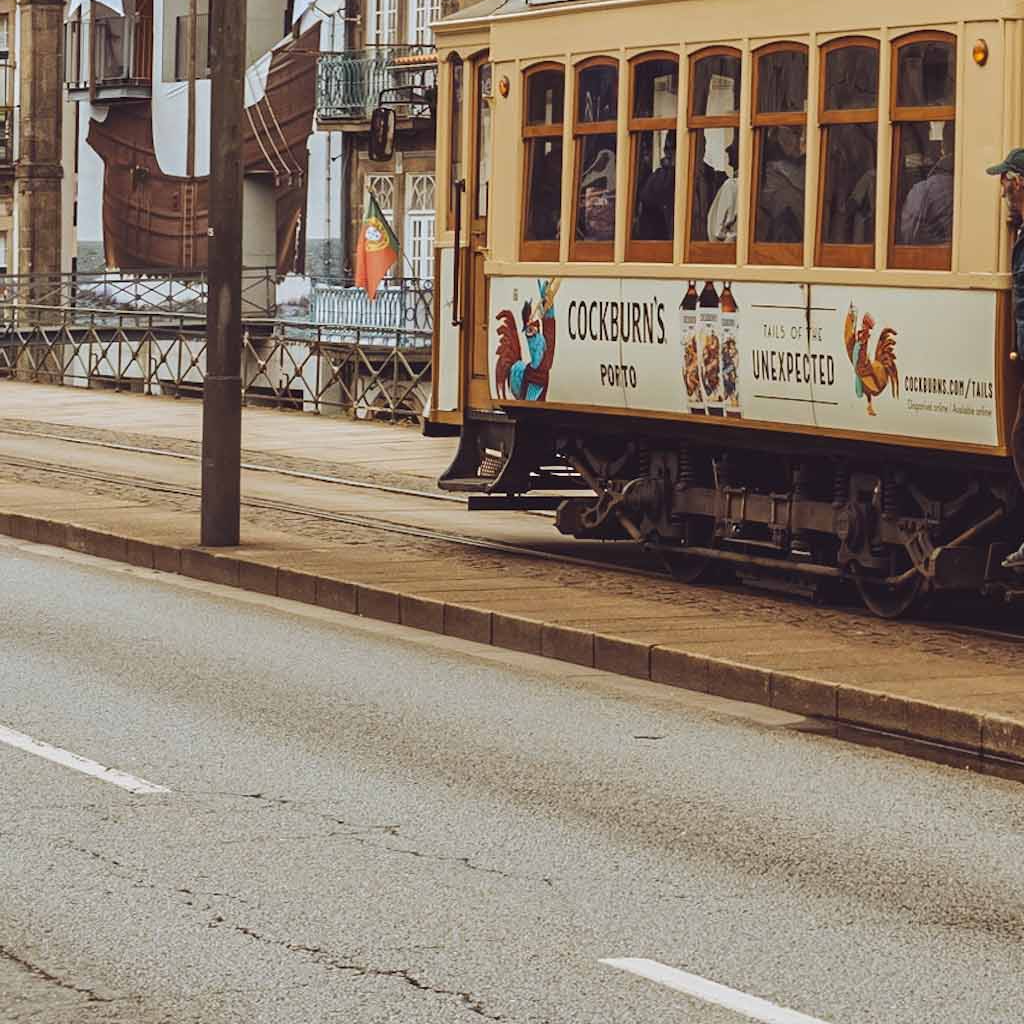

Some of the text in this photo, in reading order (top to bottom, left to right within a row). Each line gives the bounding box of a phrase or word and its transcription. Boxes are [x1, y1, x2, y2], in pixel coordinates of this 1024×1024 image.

[567, 296, 667, 345] COCKBURN'S
[762, 323, 823, 342] TAILS OF THE
[599, 363, 637, 389] PORTO
[751, 349, 835, 386] UNEXPECTED
